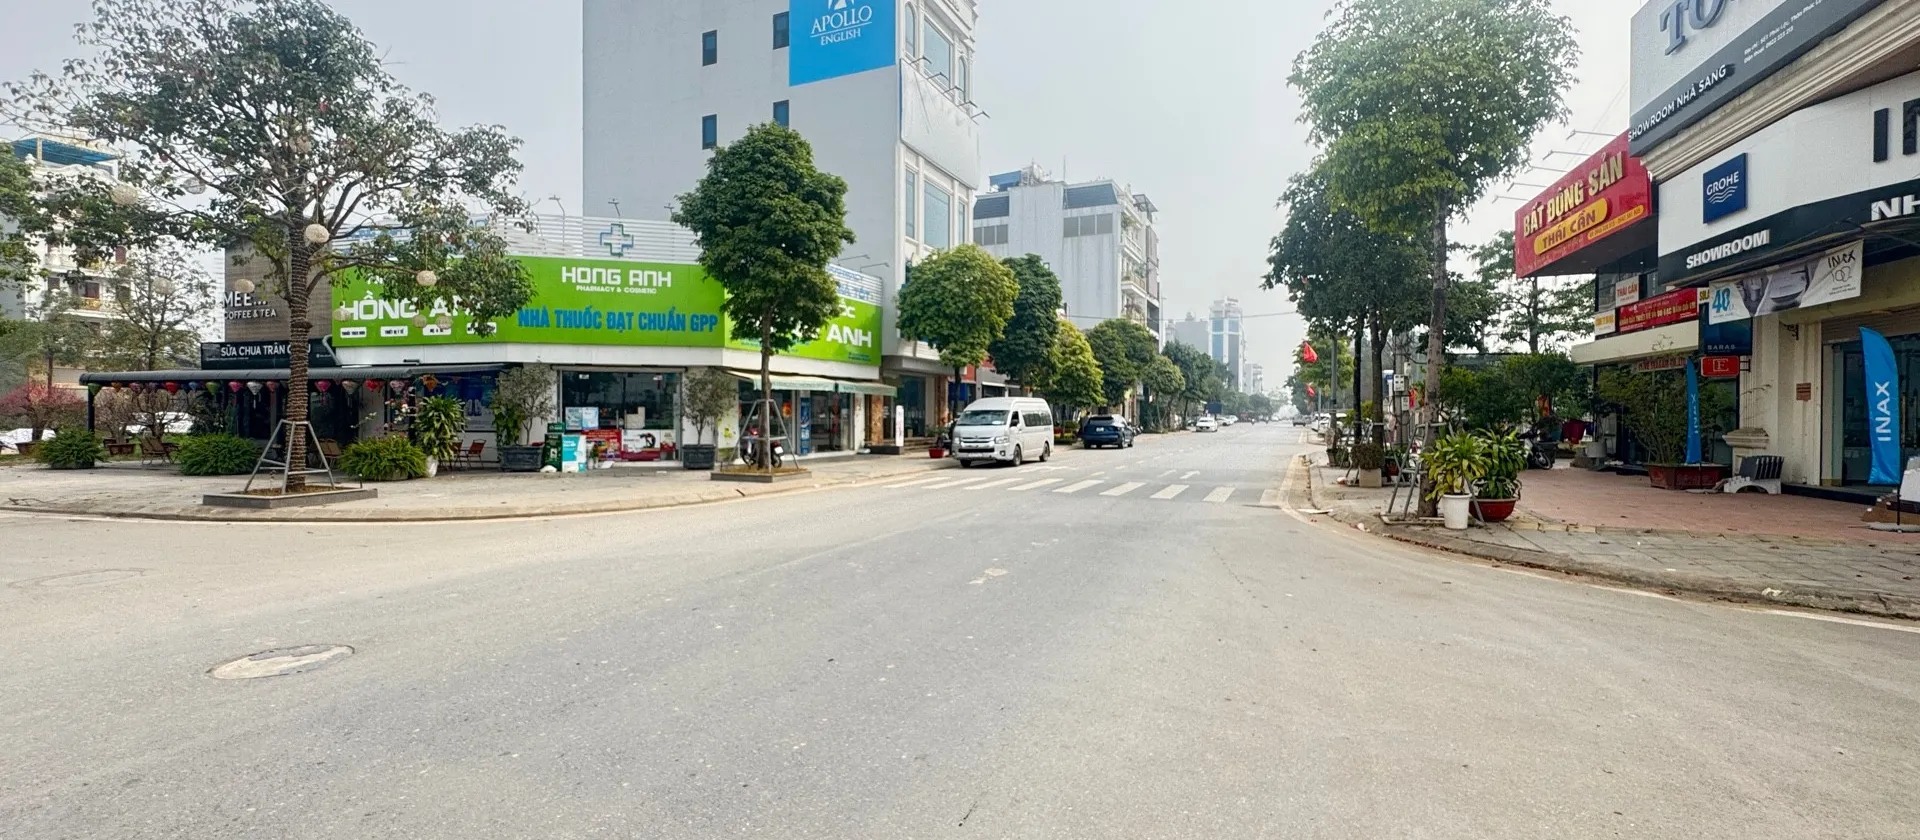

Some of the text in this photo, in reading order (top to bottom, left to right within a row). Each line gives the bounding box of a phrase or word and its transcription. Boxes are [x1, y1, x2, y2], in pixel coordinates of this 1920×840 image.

[811, 5, 872, 34] APOLLO
[820, 28, 861, 46] ENGLISH
[1628, 64, 1727, 142] SHOWROOM NHÀ SANG
[1523, 200, 1545, 238] BẤT
[1588, 151, 1624, 197] SẢN
[1706, 171, 1739, 195] GROHE
[1542, 223, 1566, 249] THÁI
[1686, 229, 1770, 270] SHOWROOM
[561, 266, 672, 288] HONG ANH
[260, 308, 276, 317] TEA
[518, 305, 550, 328] NHÀ
[555, 305, 602, 329] THUỐC
[607, 311, 634, 333] ĐẠT
[690, 313, 718, 333] GPP
[826, 323, 872, 348] ANH
[239, 345, 262, 356] CHUA
[263, 342, 285, 355] TRÂN
[1874, 381, 1892, 441] INAX
